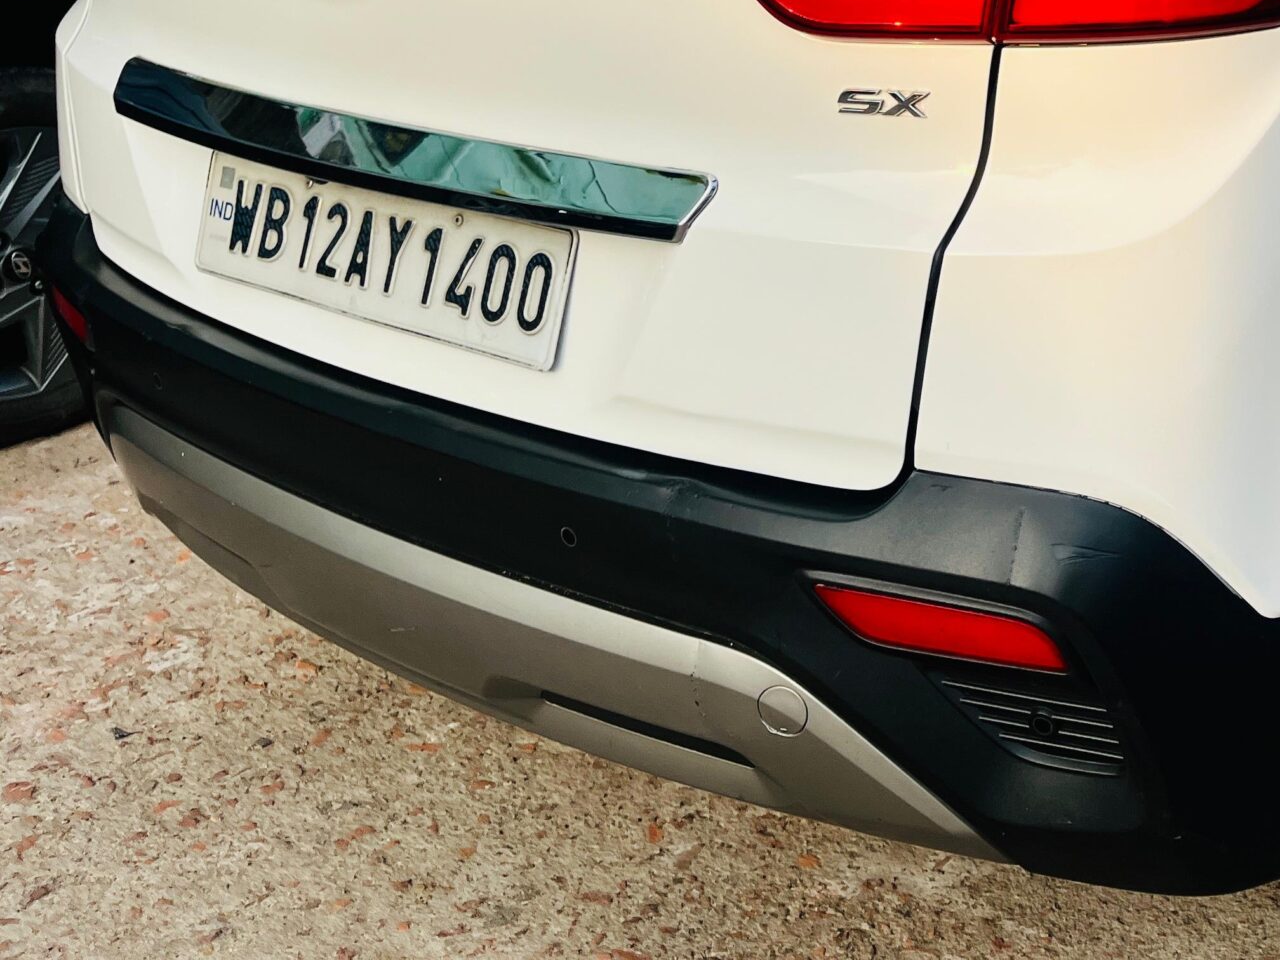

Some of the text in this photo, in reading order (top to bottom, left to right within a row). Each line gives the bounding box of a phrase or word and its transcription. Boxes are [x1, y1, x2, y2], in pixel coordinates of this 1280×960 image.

[837, 88, 931, 118] SX
[208, 197, 233, 222] IND
[228, 178, 554, 332] WB12AY1400
